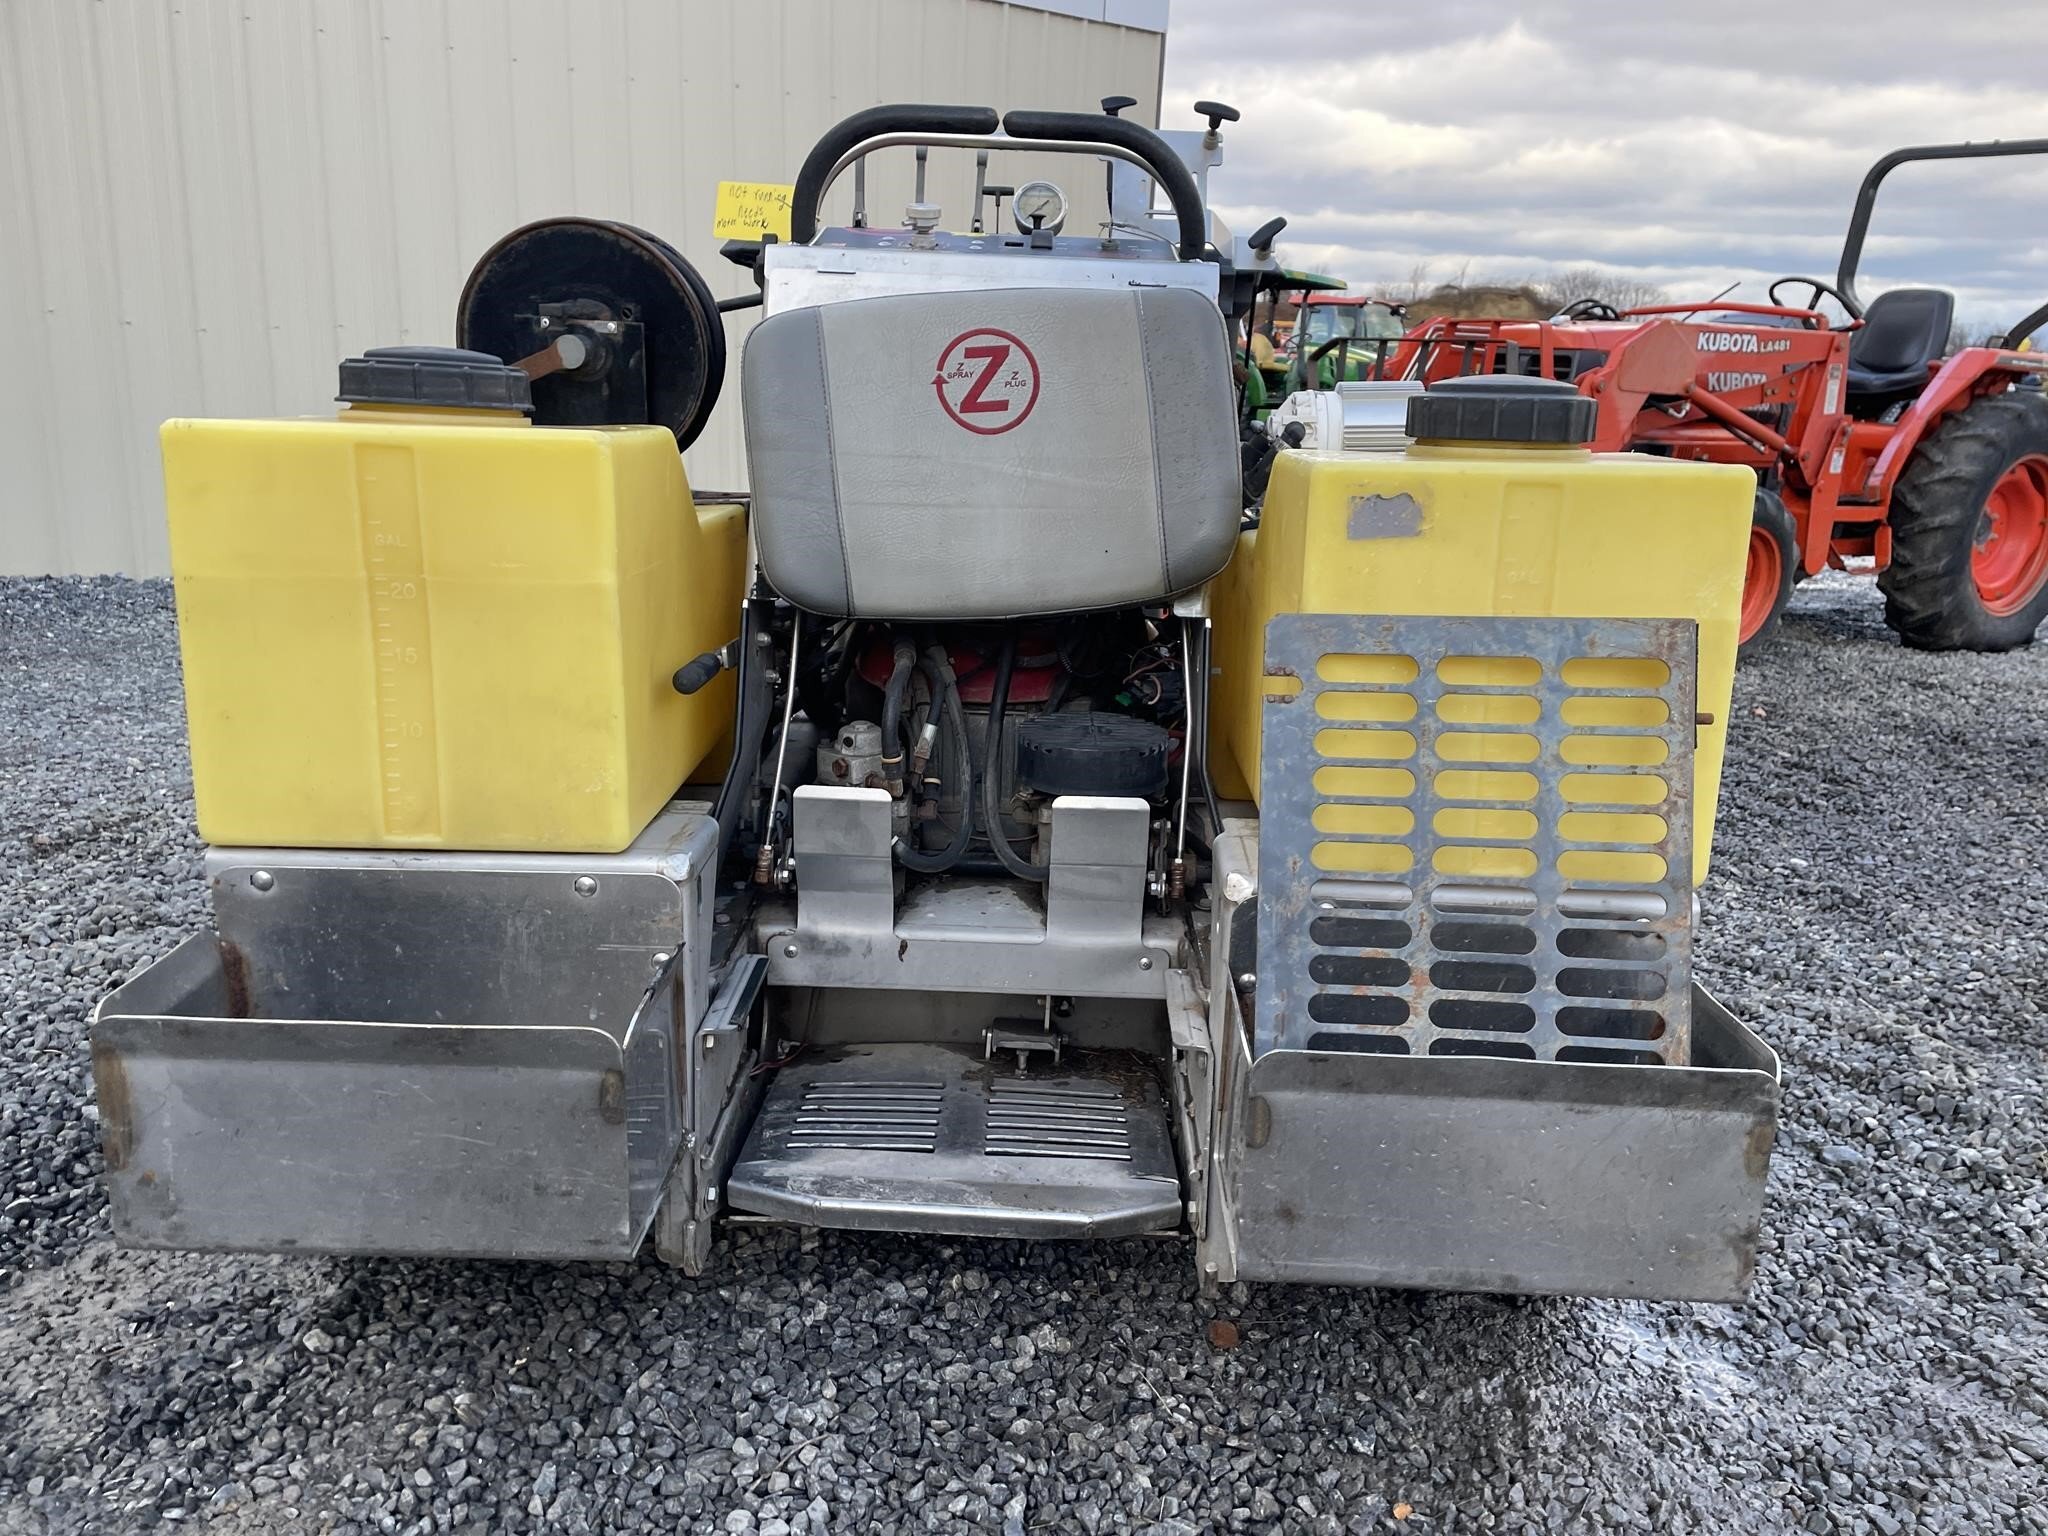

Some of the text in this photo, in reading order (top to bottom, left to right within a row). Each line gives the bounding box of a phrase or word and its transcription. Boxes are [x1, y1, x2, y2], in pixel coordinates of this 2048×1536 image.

[1697, 332, 1791, 353] KUBOTA LA481
[956, 362, 965, 371] Z
[947, 371, 974, 379] SPRAY
[959, 344, 1010, 413] Z
[1011, 371, 1019, 380] Z
[1004, 380, 1027, 388] PLUG
[391, 583, 416, 599] 20
[395, 647, 418, 664] 15
[400, 722, 423, 738] 10
